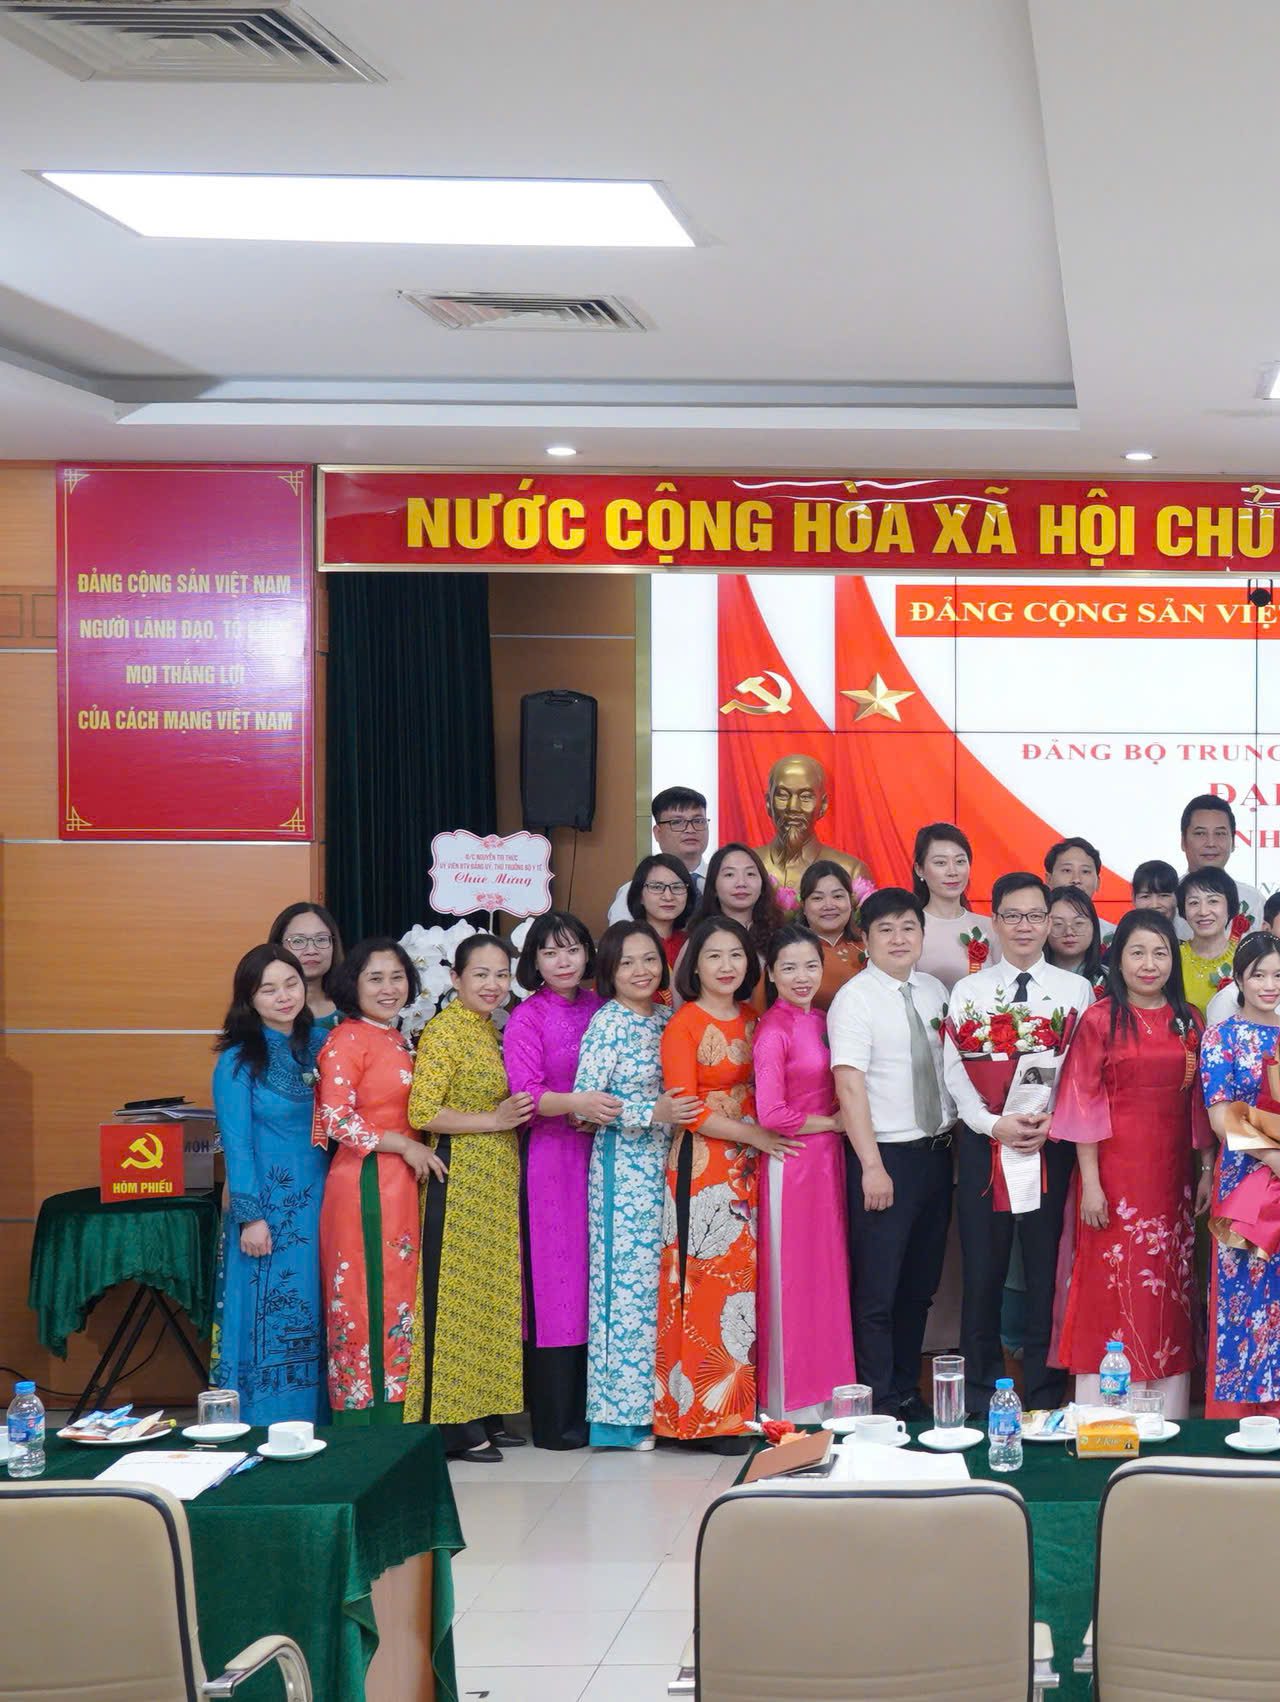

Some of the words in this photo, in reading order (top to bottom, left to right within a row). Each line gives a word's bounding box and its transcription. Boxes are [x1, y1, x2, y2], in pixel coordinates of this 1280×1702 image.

[407, 479, 585, 550] NƯỚC
[605, 482, 773, 563] CỘNG
[794, 480, 914, 554] HÒA
[932, 486, 1017, 554] XÃ
[1039, 488, 1134, 567] HỘI
[1156, 485, 1275, 558] CHỦ
[77, 567, 122, 594] ĐẢNG
[127, 570, 171, 597] CỘNG
[177, 567, 210, 594] SẢN
[214, 570, 248, 597] VIỆT
[253, 575, 291, 594] NAM
[79, 614, 129, 640] NGƯỜI
[135, 615, 176, 640] LÃNH
[909, 596, 1015, 623] ĐẢNG
[1023, 599, 1129, 628] CỘNG
[1137, 597, 1206, 624] SẢN
[126, 664, 157, 688] MỌI
[162, 656, 215, 685] THẮNG
[78, 704, 110, 731] CỦA
[116, 706, 158, 731] CÁCH
[164, 711, 211, 734] MẠNG
[217, 707, 250, 734] VIỆT
[255, 712, 292, 731] NAM
[1124, 741, 1166, 765] BỘ
[113, 1180, 138, 1194] HÒM
[141, 1178, 173, 1193] PHIẾU
